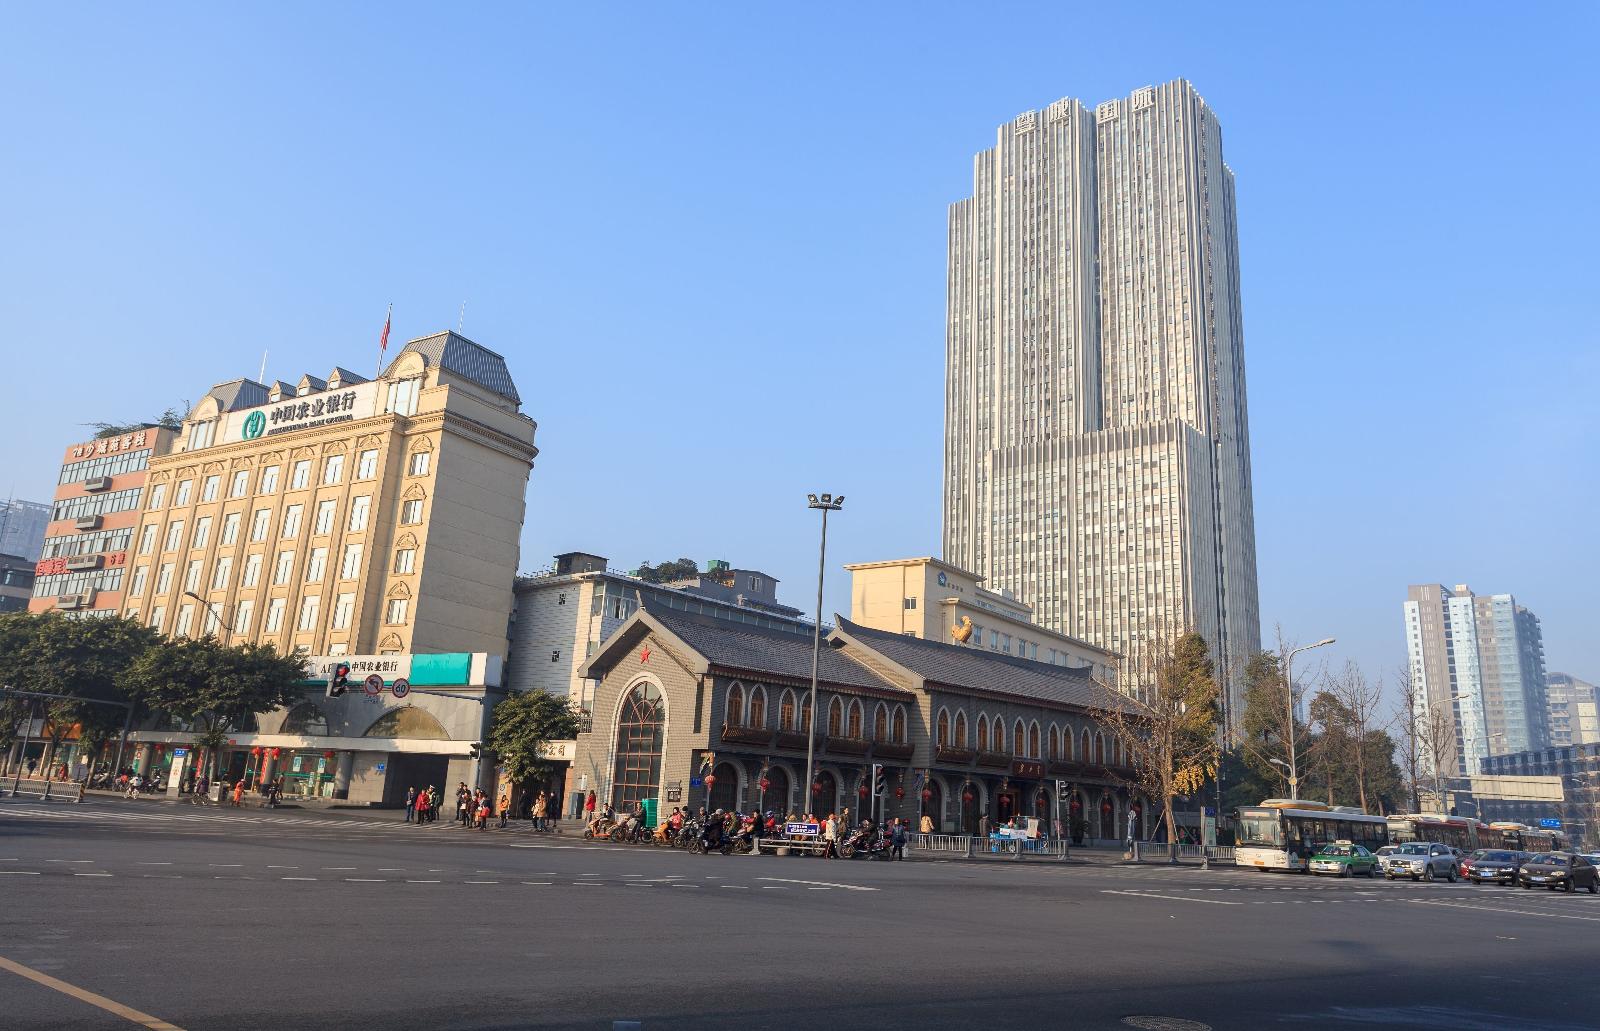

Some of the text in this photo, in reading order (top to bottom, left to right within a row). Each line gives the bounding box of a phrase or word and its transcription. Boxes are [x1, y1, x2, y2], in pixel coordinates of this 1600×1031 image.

[270, 391, 356, 424] 中国农业银行
[352, 661, 398, 672] 中国农业银行
[395, 684, 406, 693] 60
